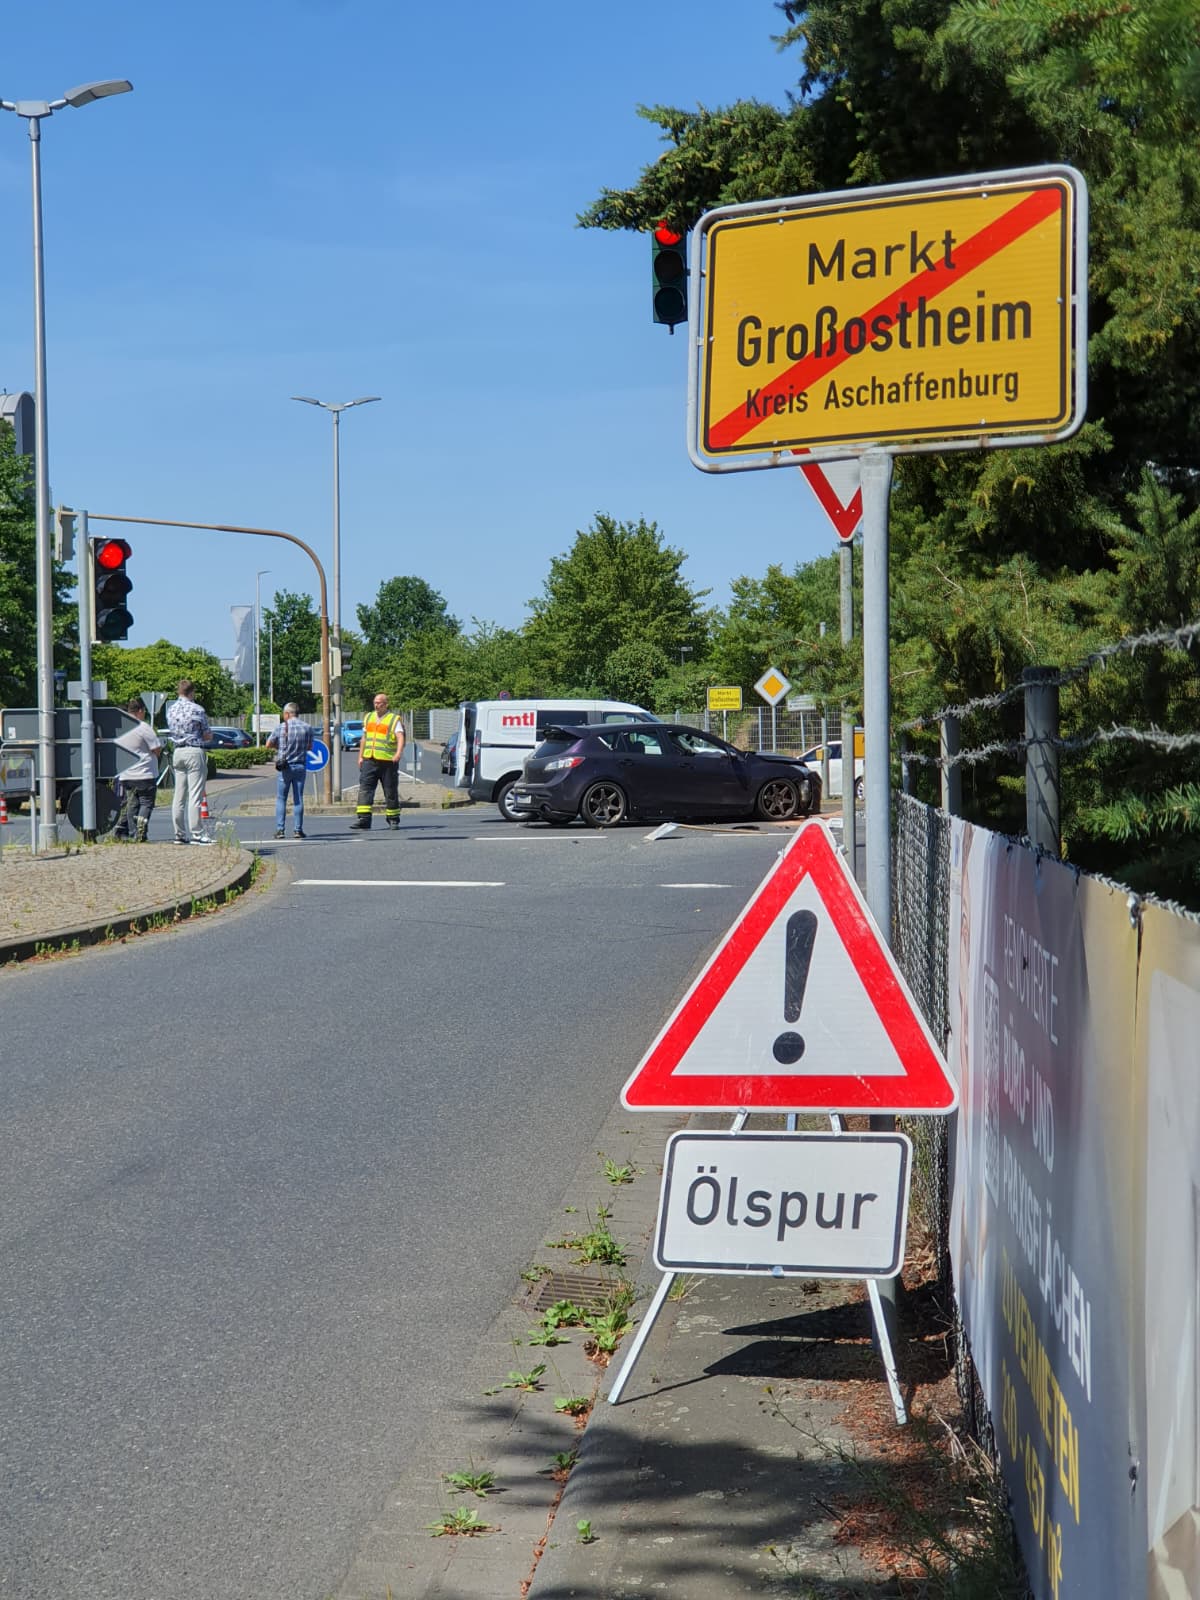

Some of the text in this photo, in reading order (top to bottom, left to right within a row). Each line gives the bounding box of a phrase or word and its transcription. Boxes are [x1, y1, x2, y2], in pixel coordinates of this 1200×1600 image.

[807, 229, 957, 285] Markt
[736, 290, 1032, 367] Großostheim
[746, 368, 1019, 419] Kreis Aschaffenburg
[502, 712, 535, 726] mtl
[1032, 1063, 1055, 1174] UND
[686, 1166, 878, 1242] Ölspur
[1003, 1134, 1091, 1403] PRAXISFLÄCHEN
[1014, 1274, 1079, 1526] VERMIETEN
